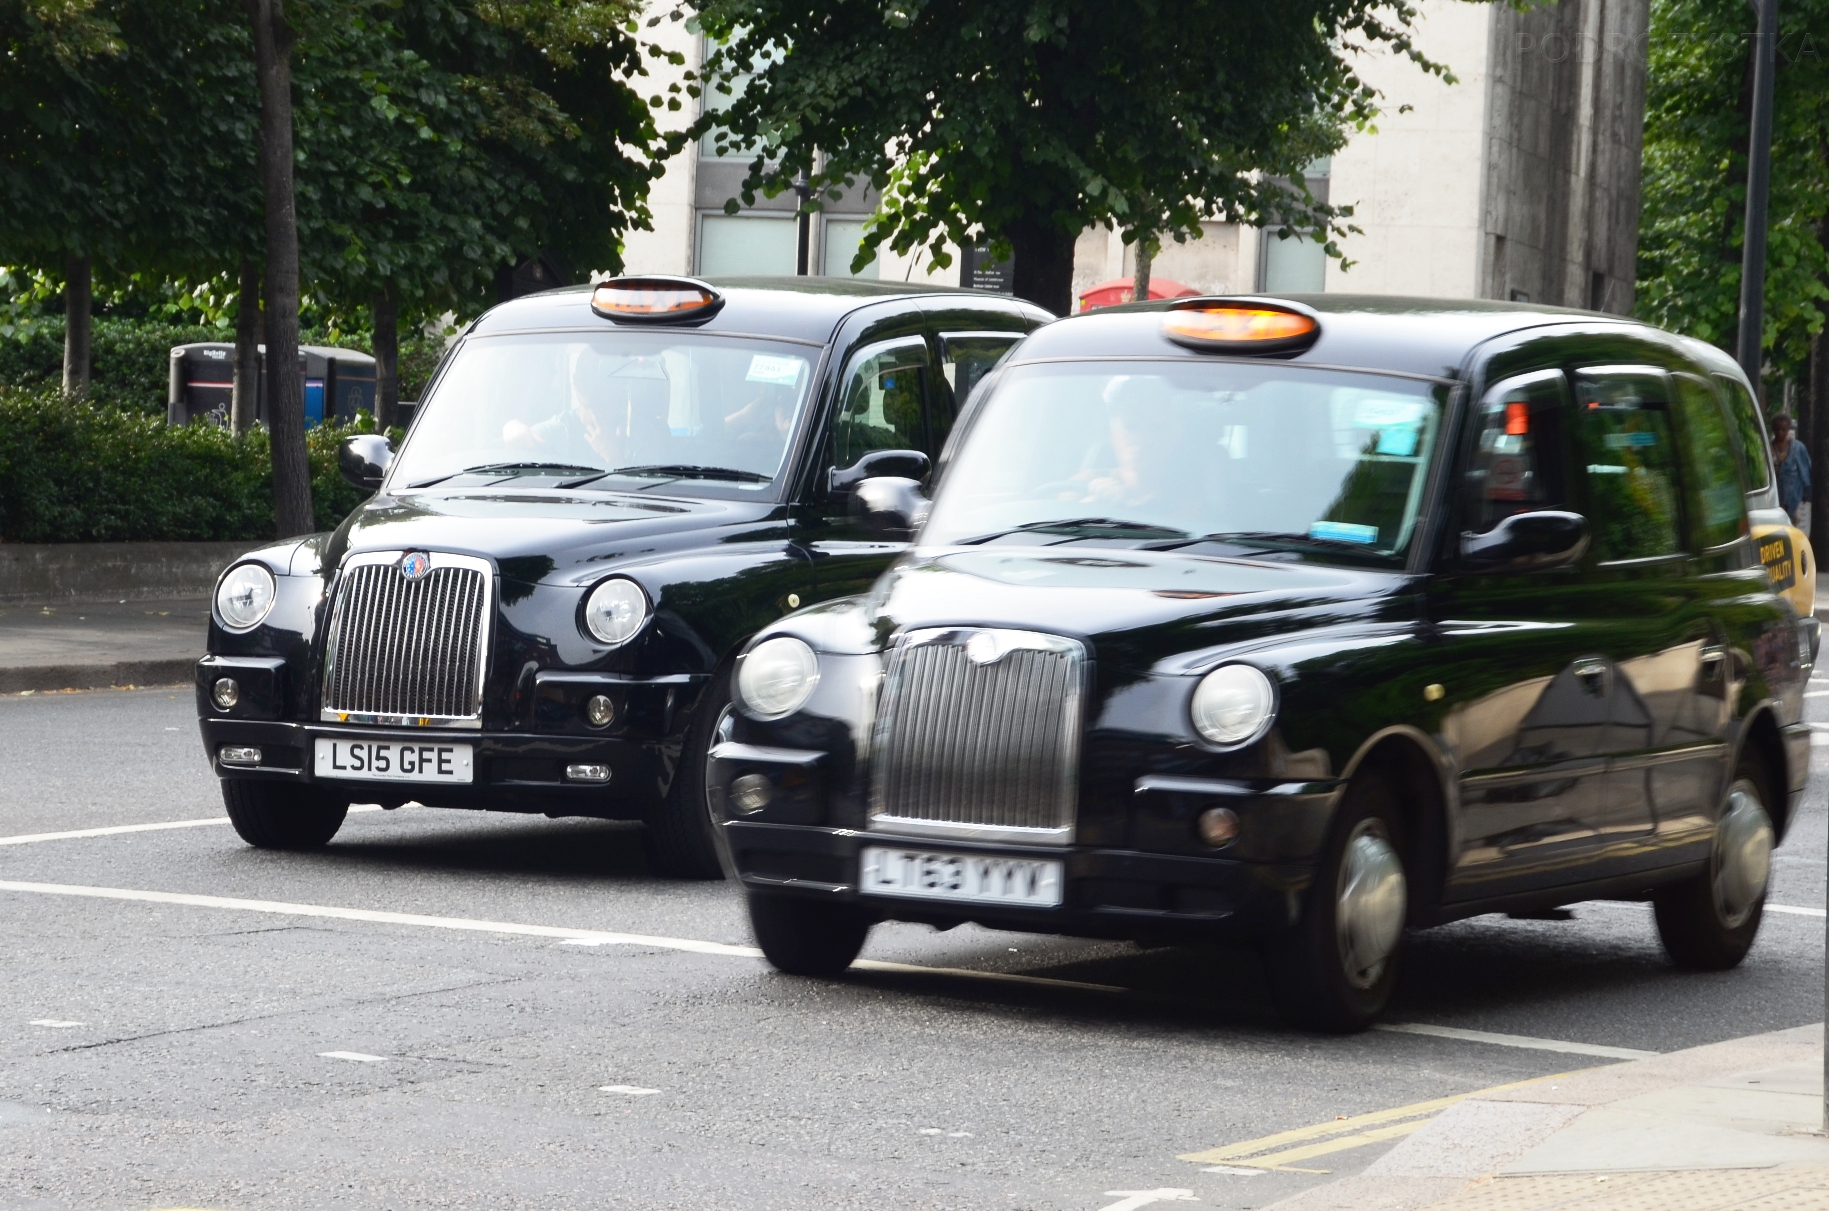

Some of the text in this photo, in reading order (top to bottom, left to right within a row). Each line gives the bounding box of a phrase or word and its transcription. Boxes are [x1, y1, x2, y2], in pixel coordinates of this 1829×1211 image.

[1760, 540, 1785, 565] DRIVEN
[332, 742, 454, 776] LS15 GFE
